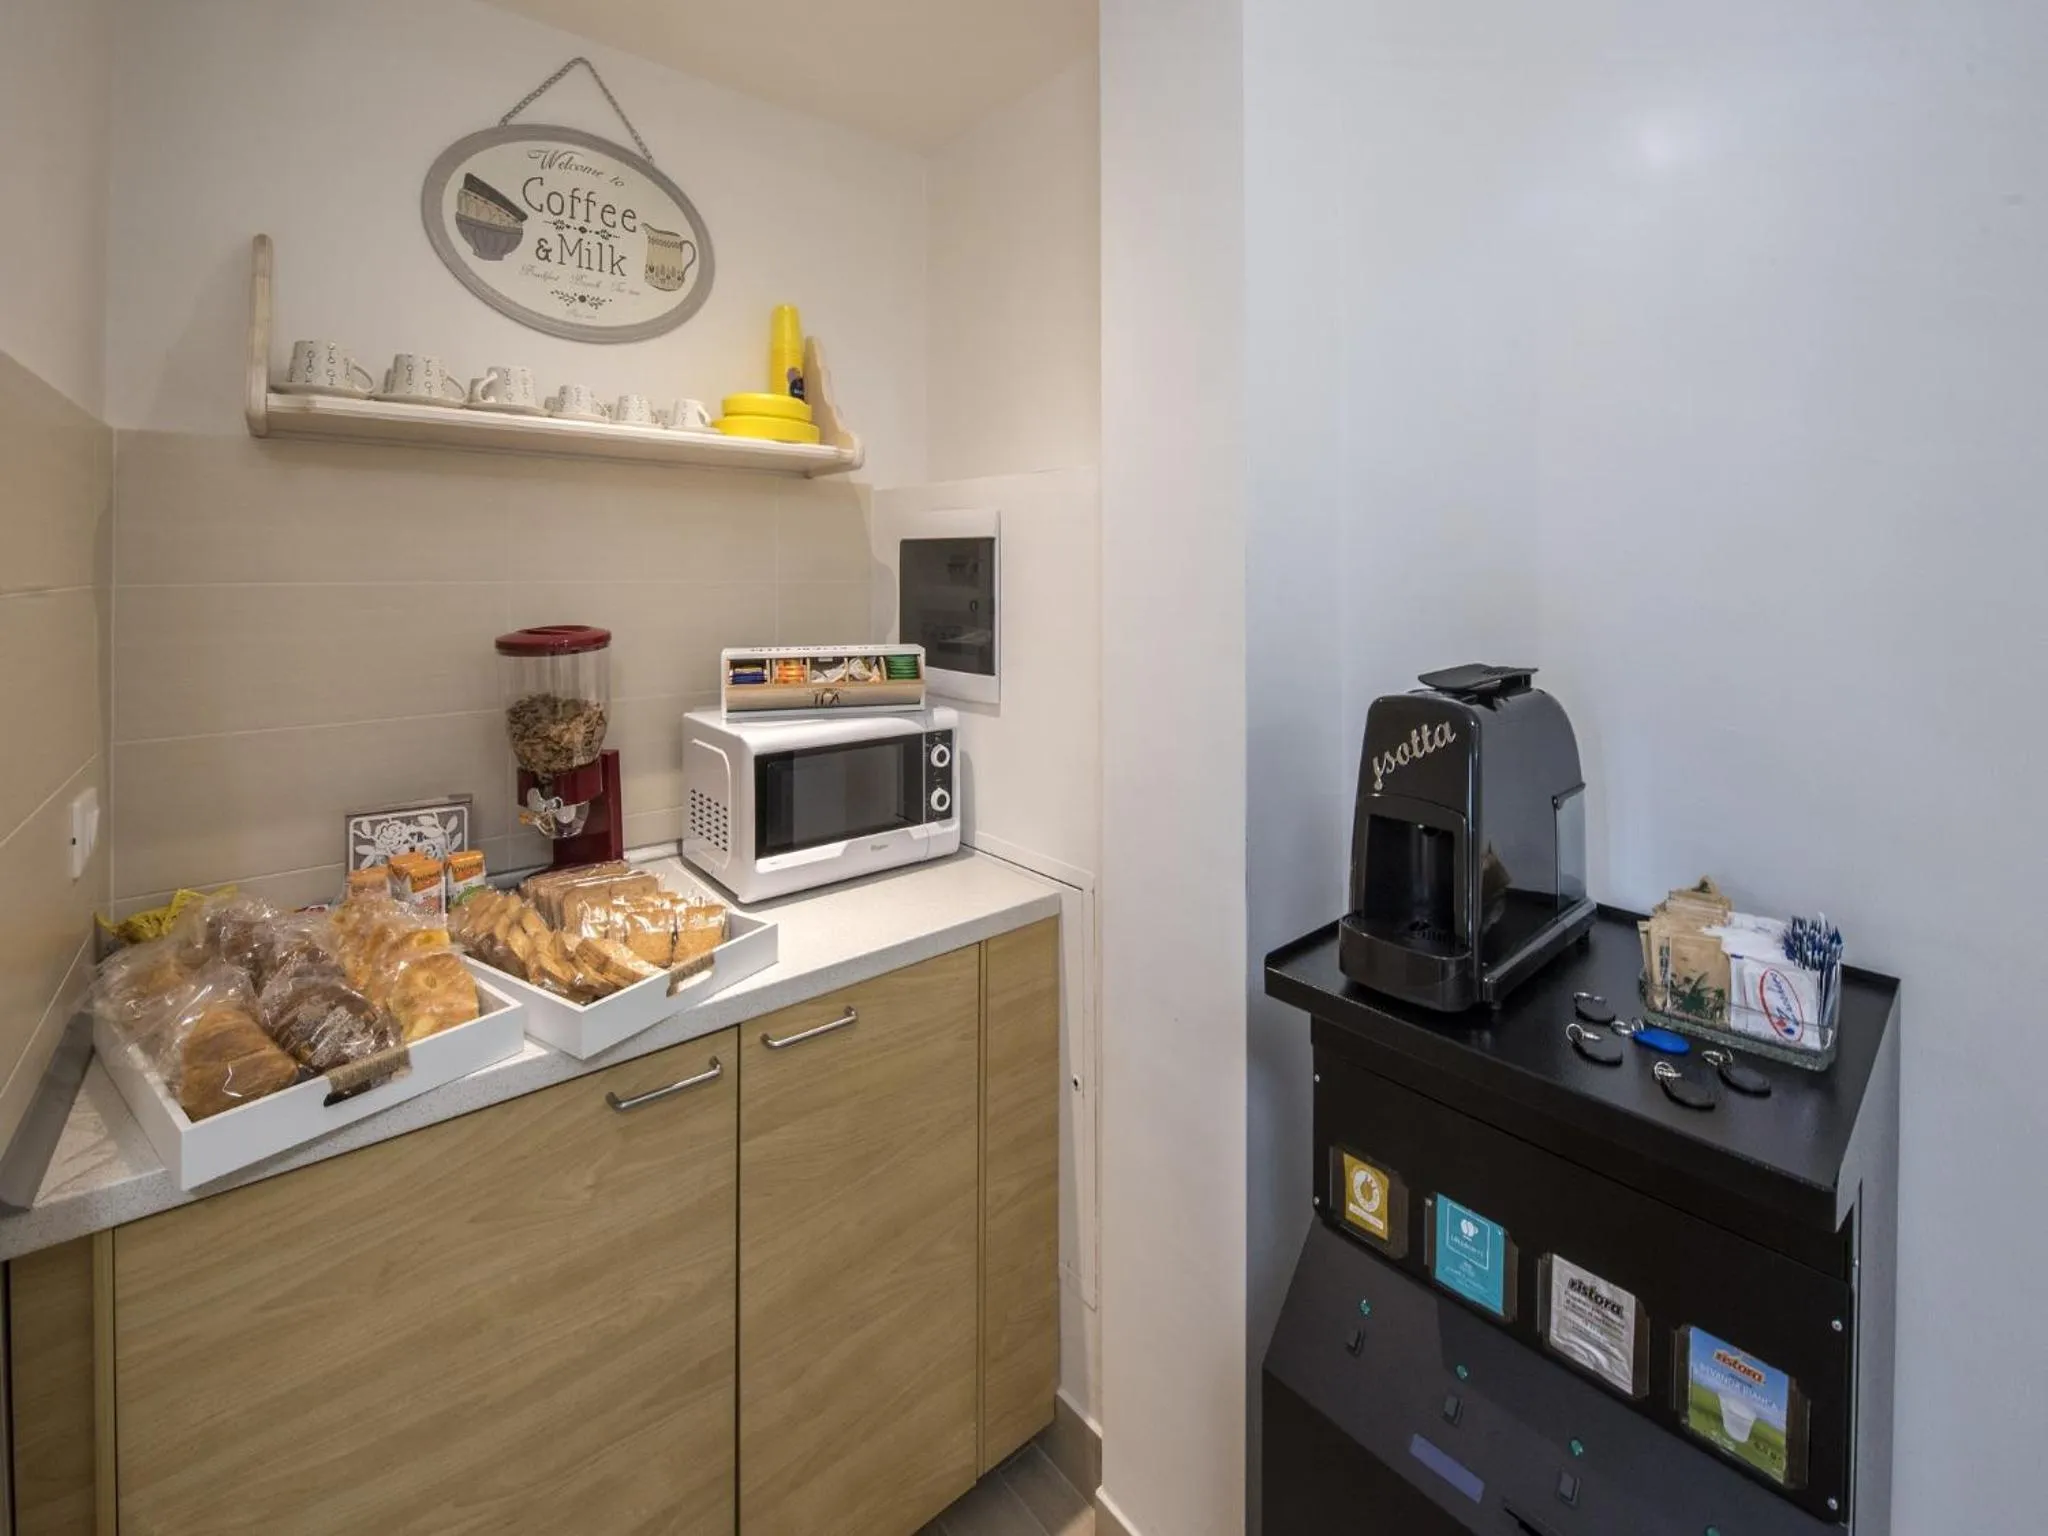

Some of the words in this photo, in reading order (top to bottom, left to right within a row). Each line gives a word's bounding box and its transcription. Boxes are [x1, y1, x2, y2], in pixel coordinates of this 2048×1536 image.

[527, 149, 604, 176] Welcome
[609, 176, 625, 187] to
[522, 176, 637, 233] Coffee
